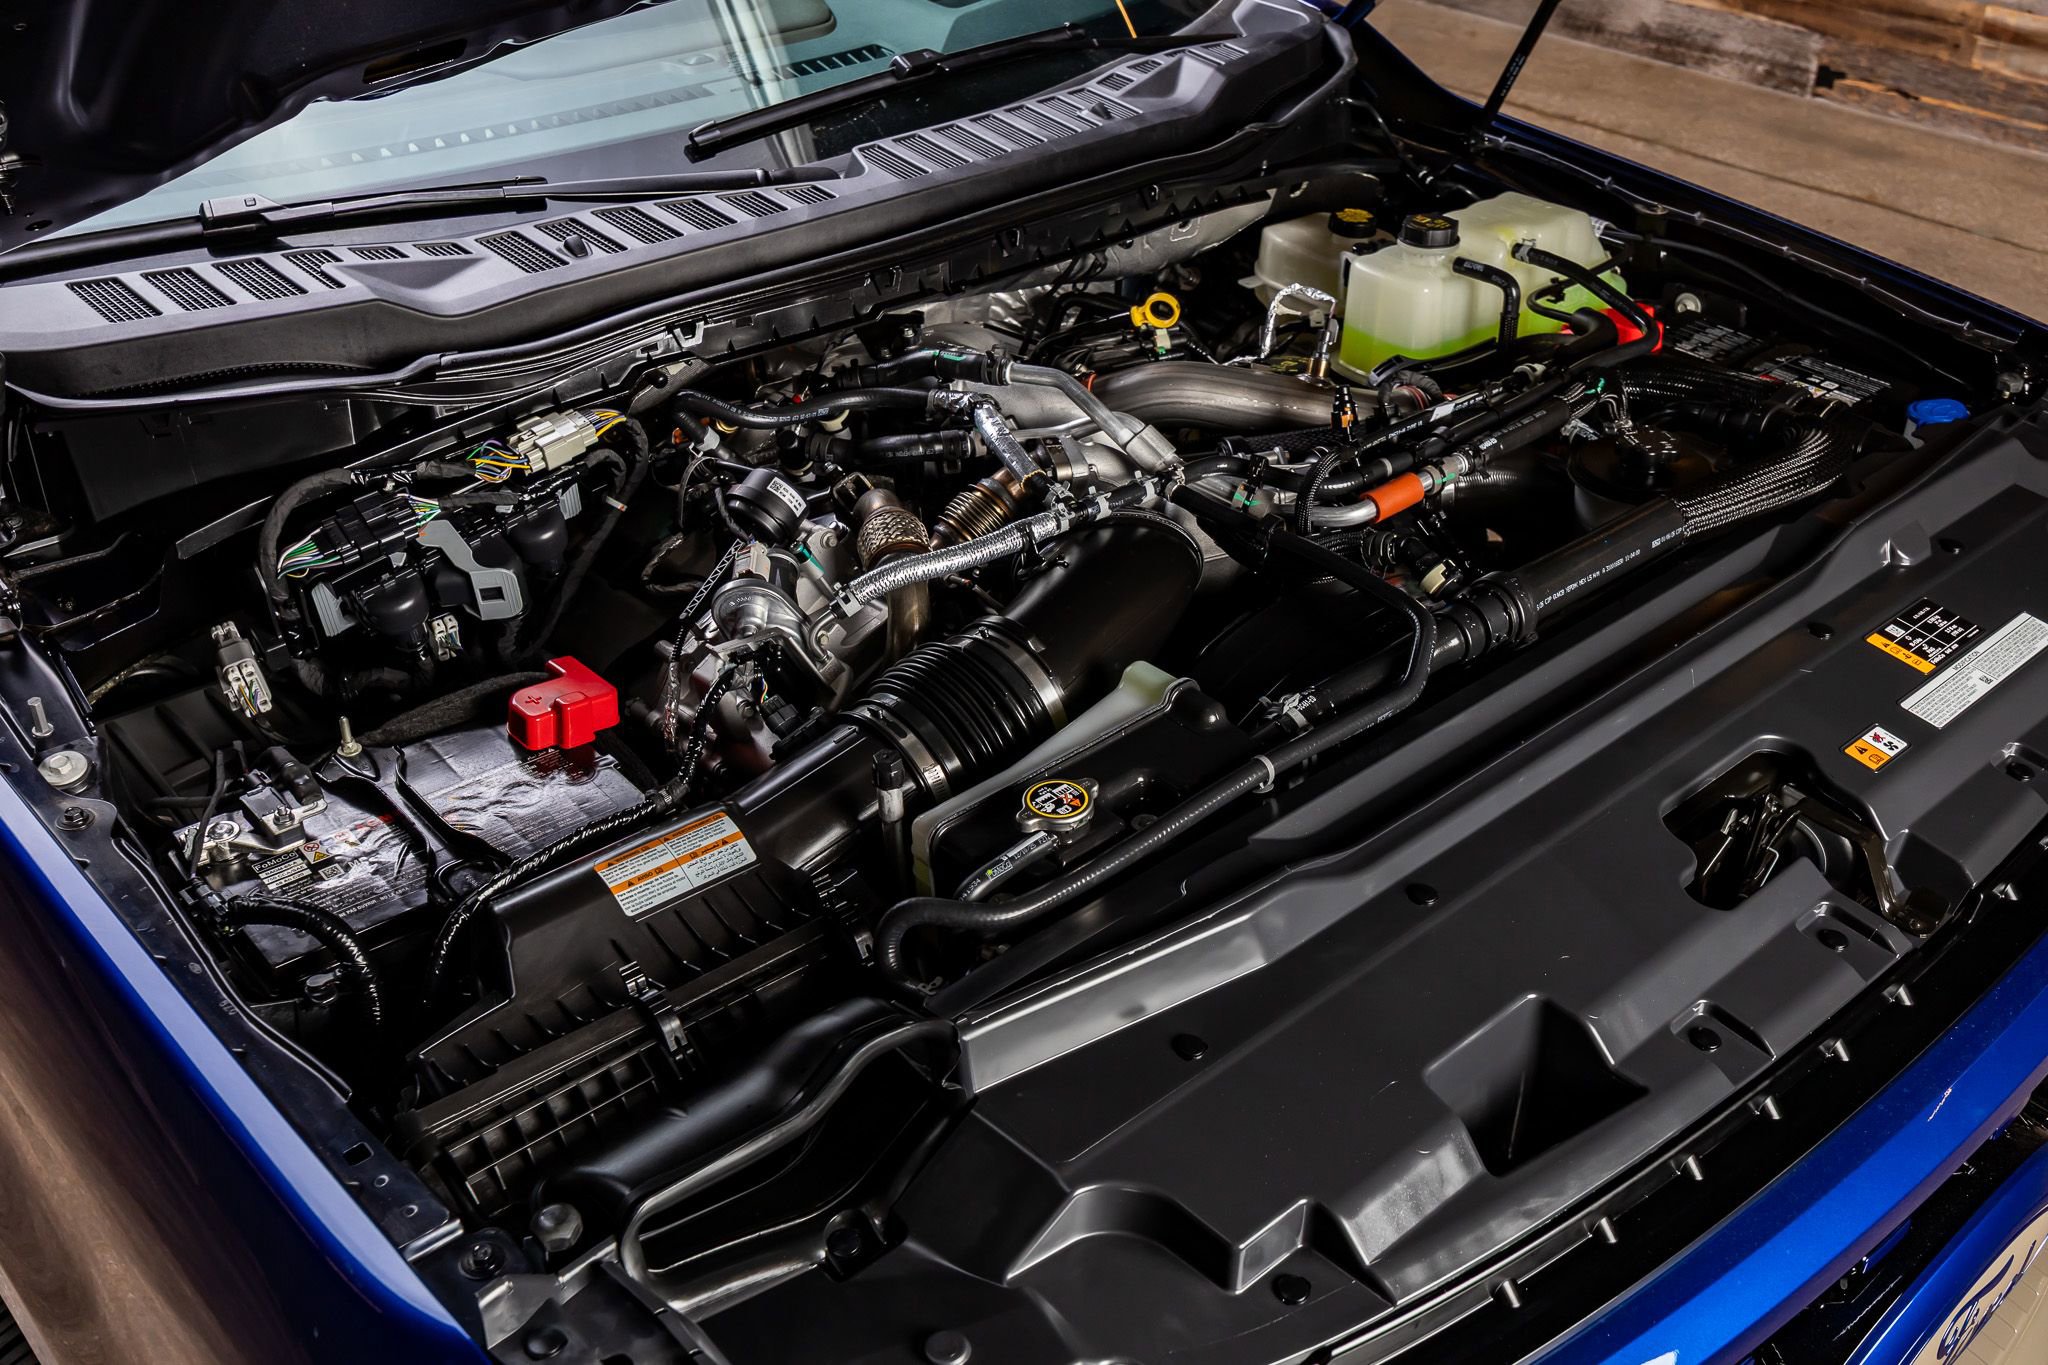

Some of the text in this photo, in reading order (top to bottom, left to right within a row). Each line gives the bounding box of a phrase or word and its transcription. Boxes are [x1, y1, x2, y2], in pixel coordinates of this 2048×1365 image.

[1952, 651, 1980, 670] MODIFICATION
[254, 852, 296, 871] FoMoCo
[637, 873, 653, 881] AVISO
[345, 906, 358, 915] PAS
